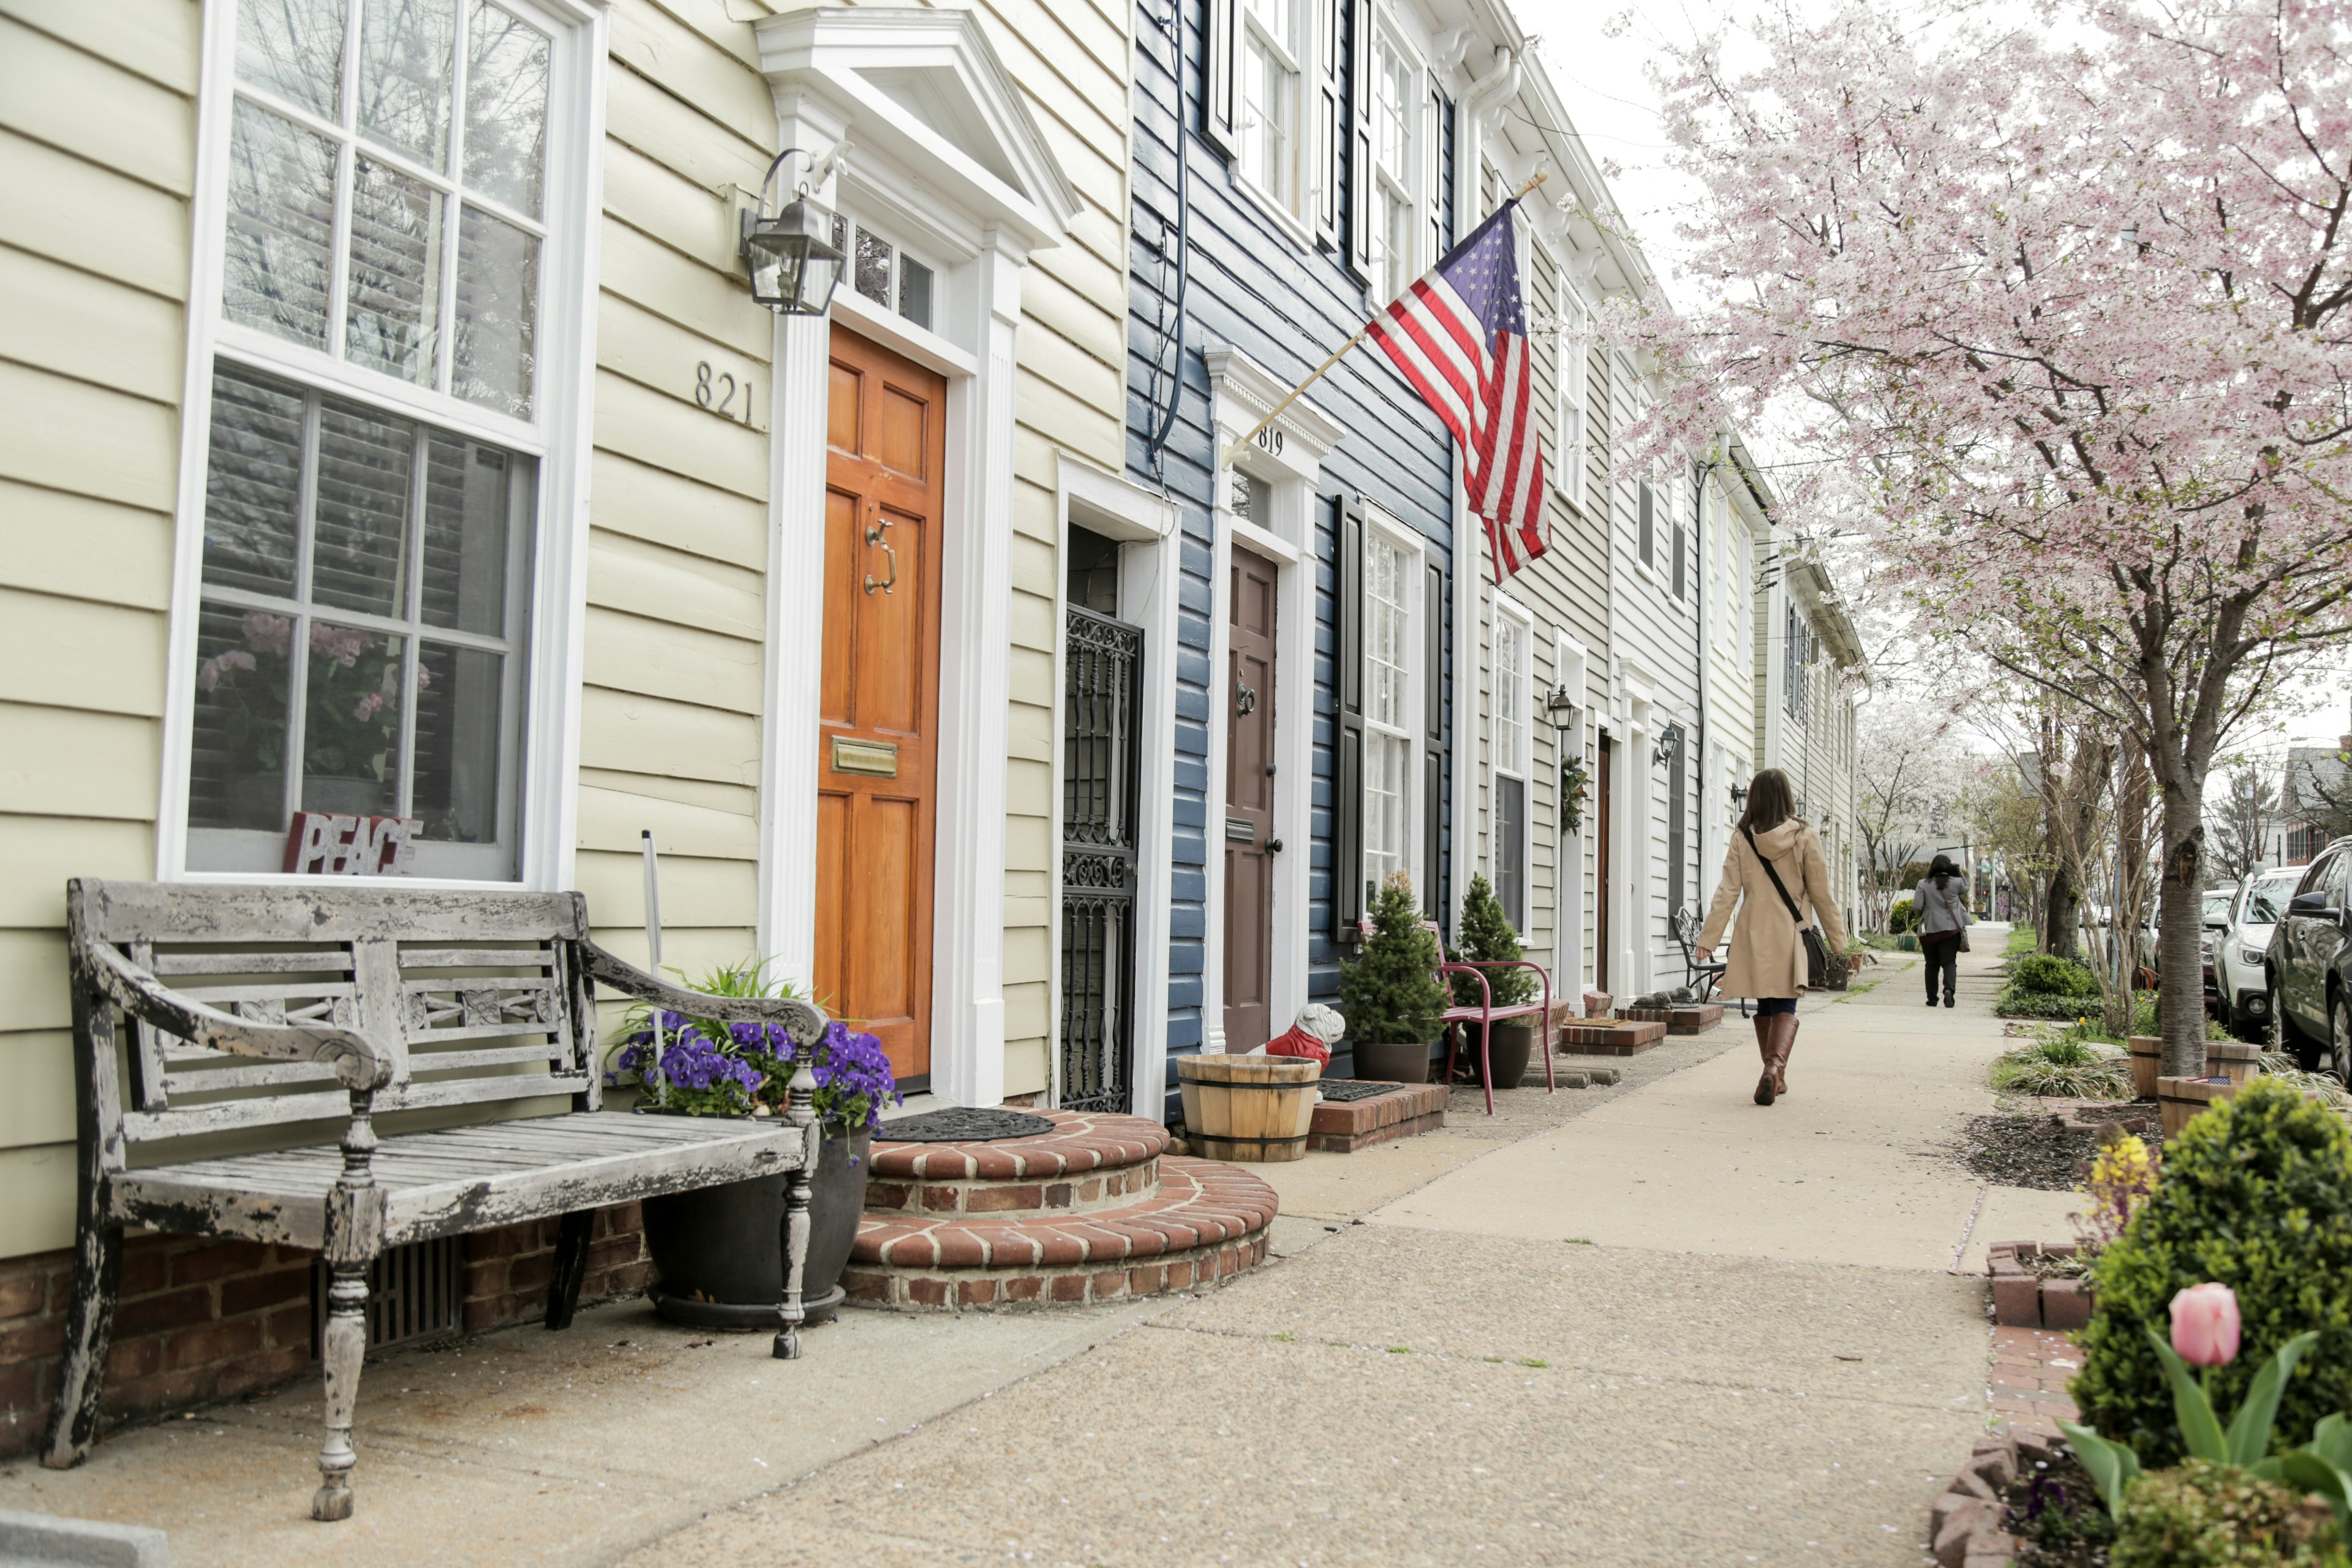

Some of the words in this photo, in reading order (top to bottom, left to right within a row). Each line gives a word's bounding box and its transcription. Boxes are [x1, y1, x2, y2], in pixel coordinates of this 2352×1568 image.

[696, 361, 752, 427] 821
[1259, 426, 1283, 456] 819
[294, 813, 424, 876] PEACE
